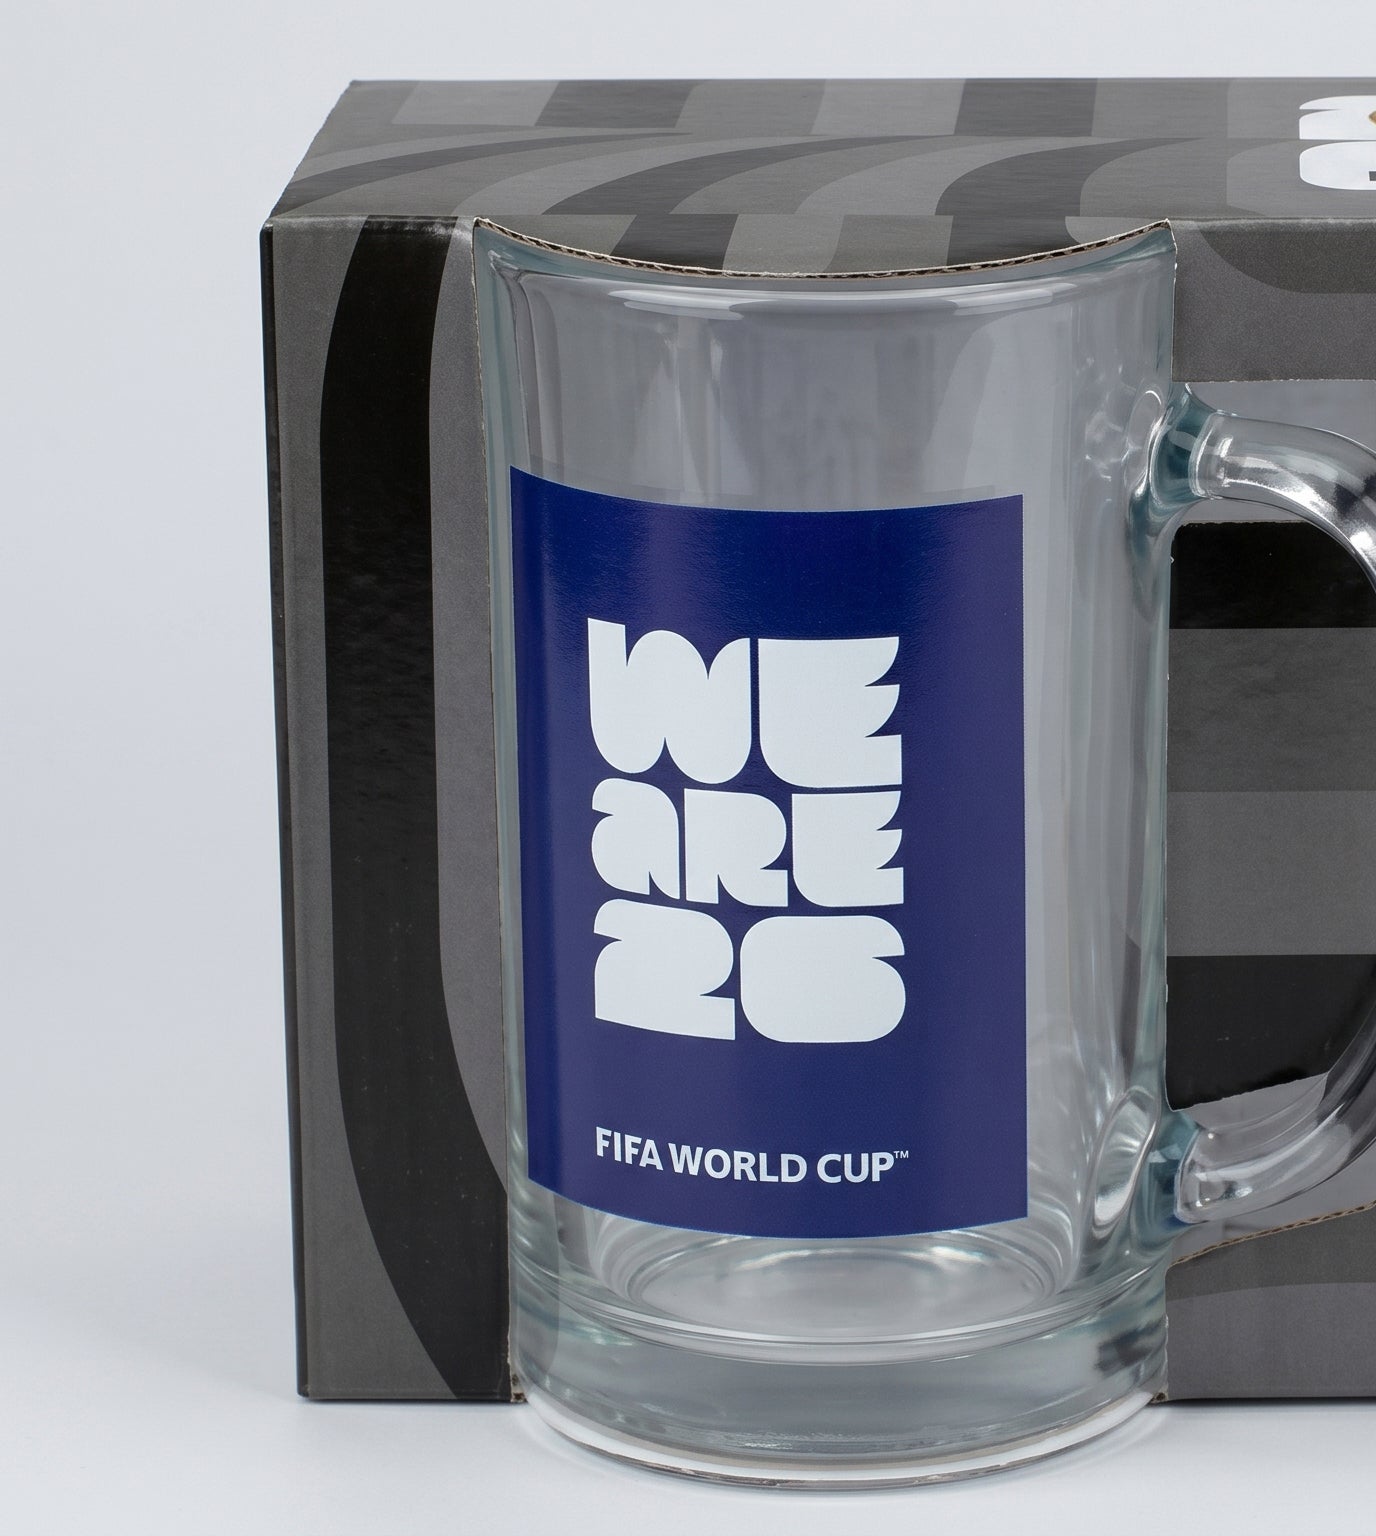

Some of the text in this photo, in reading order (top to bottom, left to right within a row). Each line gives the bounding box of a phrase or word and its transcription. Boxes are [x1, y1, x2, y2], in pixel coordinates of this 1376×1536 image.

[588, 618, 903, 788] WE
[596, 1126, 664, 1171] FIFA
[668, 1142, 807, 1183] WORLD
